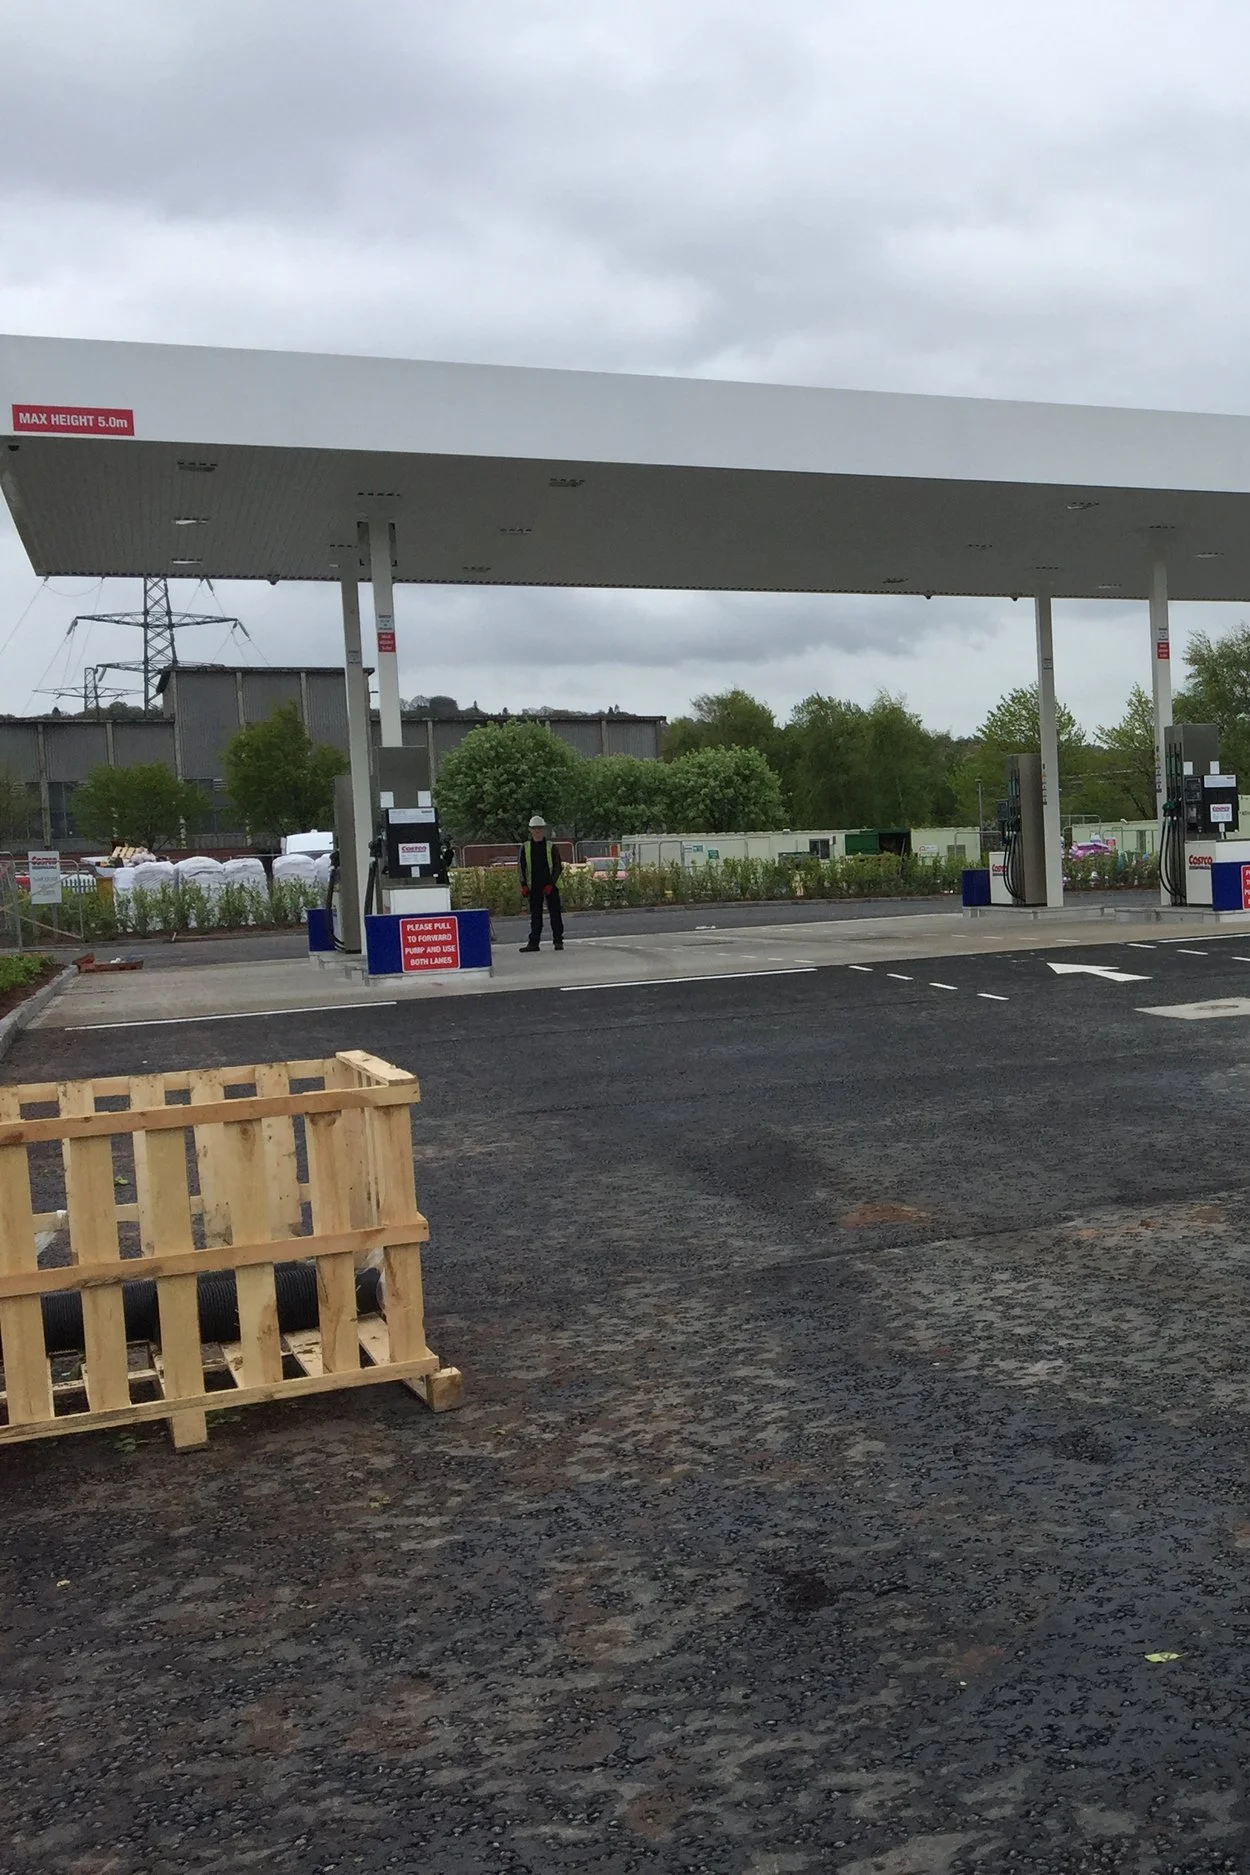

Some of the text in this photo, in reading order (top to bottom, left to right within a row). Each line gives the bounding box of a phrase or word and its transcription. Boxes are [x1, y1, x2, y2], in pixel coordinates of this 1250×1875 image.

[19, 412, 128, 428] MAX HEIGHT 5.0m
[1188, 854, 1213, 865] COSTCO
[407, 922, 451, 931] PLEASE PULL
[407, 933, 452, 943] TO FORWARD
[405, 945, 456, 955] PUMP AND USE
[410, 957, 452, 966] BOTH LANES
